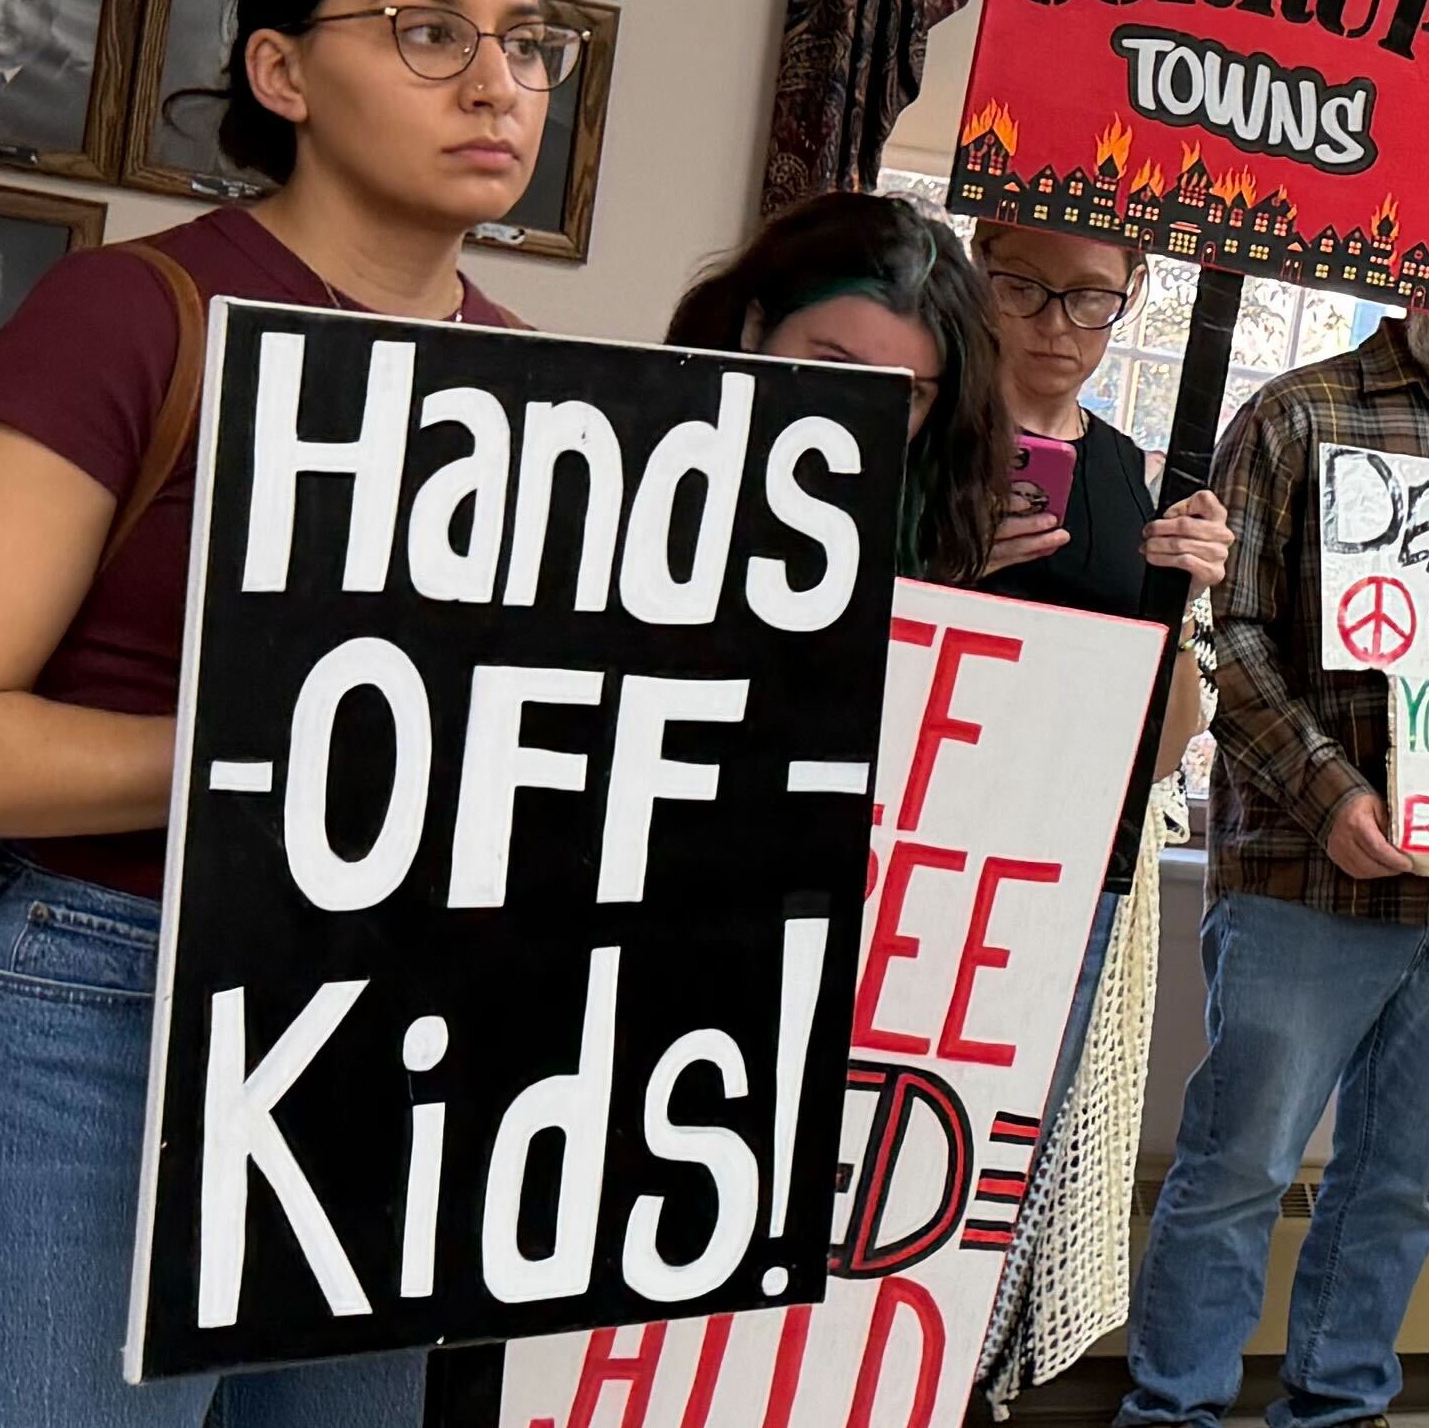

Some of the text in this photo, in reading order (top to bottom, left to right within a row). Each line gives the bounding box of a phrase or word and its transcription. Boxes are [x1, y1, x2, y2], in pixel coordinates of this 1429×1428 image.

[1119, 36, 1368, 165] TOWNS
[241, 332, 863, 632] Hands
[197, 917, 829, 1328] Kids!
